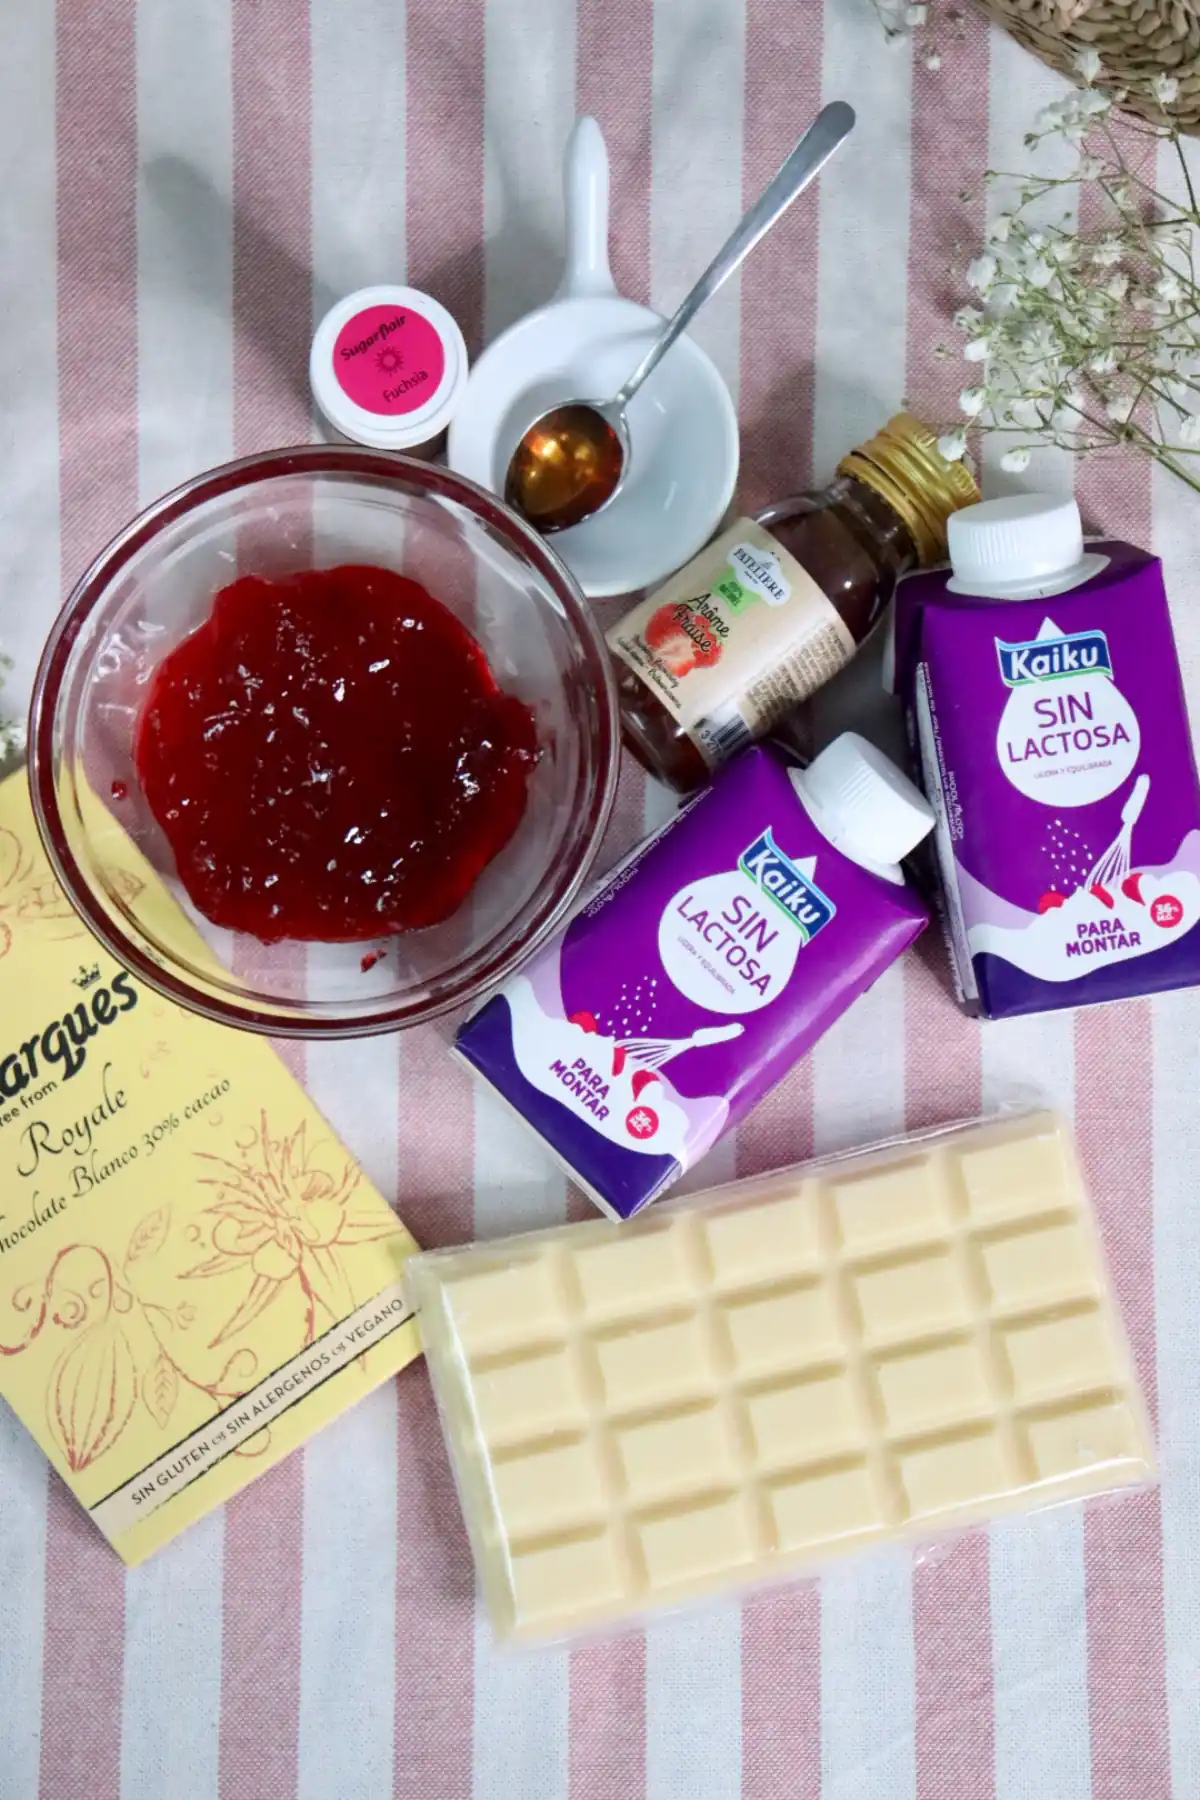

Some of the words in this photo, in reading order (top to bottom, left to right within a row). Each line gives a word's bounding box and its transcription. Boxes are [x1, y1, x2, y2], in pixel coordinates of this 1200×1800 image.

[341, 316, 405, 360] Sugarflair
[382, 369, 429, 403] Fuchsia
[672, 603, 712, 652] Fraise
[688, 593, 730, 638] Arôme
[1010, 643, 1098, 681] Kaiku
[1033, 691, 1094, 729] SIN
[1007, 722, 1131, 763] LACTOSA
[748, 849, 821, 924] Kaiku
[677, 895, 771, 996] LACTOSA
[721, 895, 779, 953] SIN
[1065, 931, 1141, 957] MONTAR
[1076, 918, 1125, 938] PARA
[0, 971, 138, 1101] arques
[20, 1080, 58, 1109] from
[549, 1059, 610, 1121] MONTAR
[571, 1058, 610, 1100] PARA
[17, 1062, 128, 1177] Royale
[69, 1149, 138, 1198] Blanco
[142, 1113, 180, 1157] 30%
[184, 1078, 231, 1119] cacao
[131, 1482, 156, 1505] SIN
[156, 1441, 211, 1487] GLUTEN
[226, 1412, 250, 1435] SIN
[253, 1352, 331, 1417] ALERGENOS
[346, 1299, 404, 1343] VEGANO
